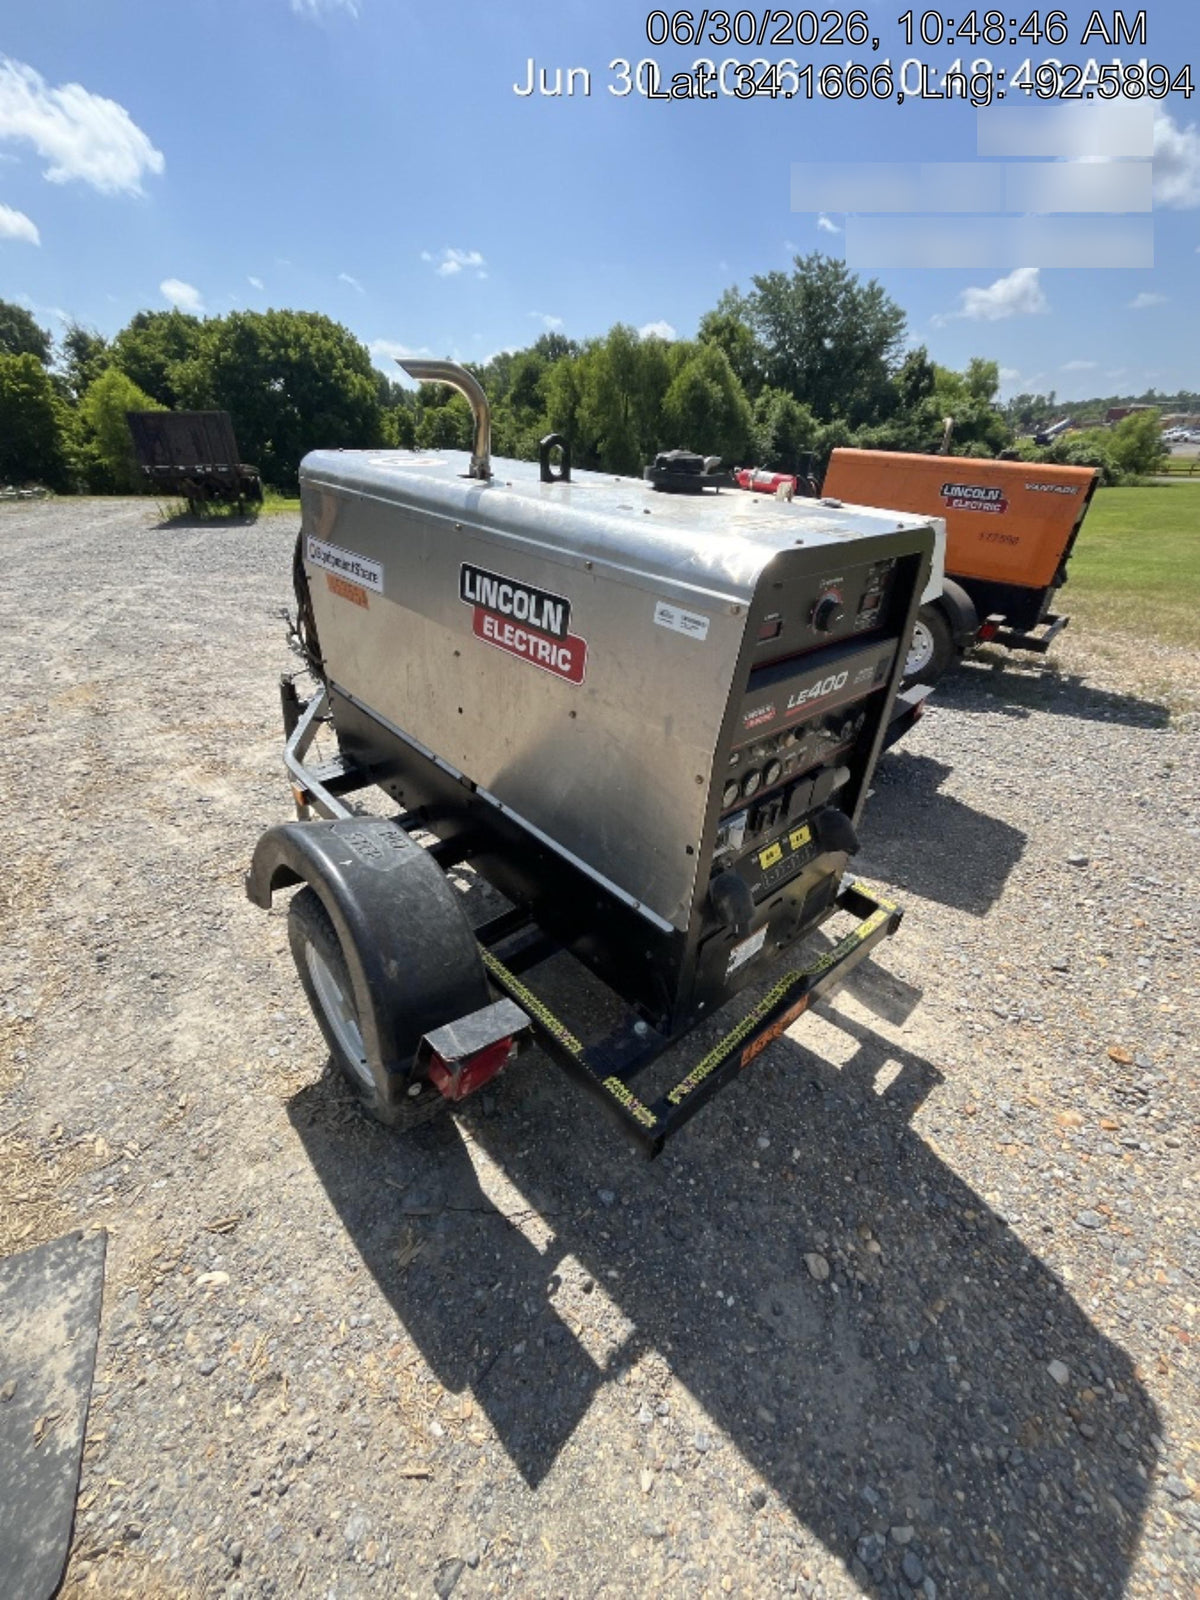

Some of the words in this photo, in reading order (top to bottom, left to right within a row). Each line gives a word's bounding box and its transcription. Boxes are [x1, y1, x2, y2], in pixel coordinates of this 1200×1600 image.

[942, 484, 1001, 500] LINCOLN
[951, 498, 1002, 512] ELECTRIC
[464, 569, 564, 636] LINCOLN
[482, 614, 572, 672] ELECTRIC
[786, 669, 849, 710] LE400
